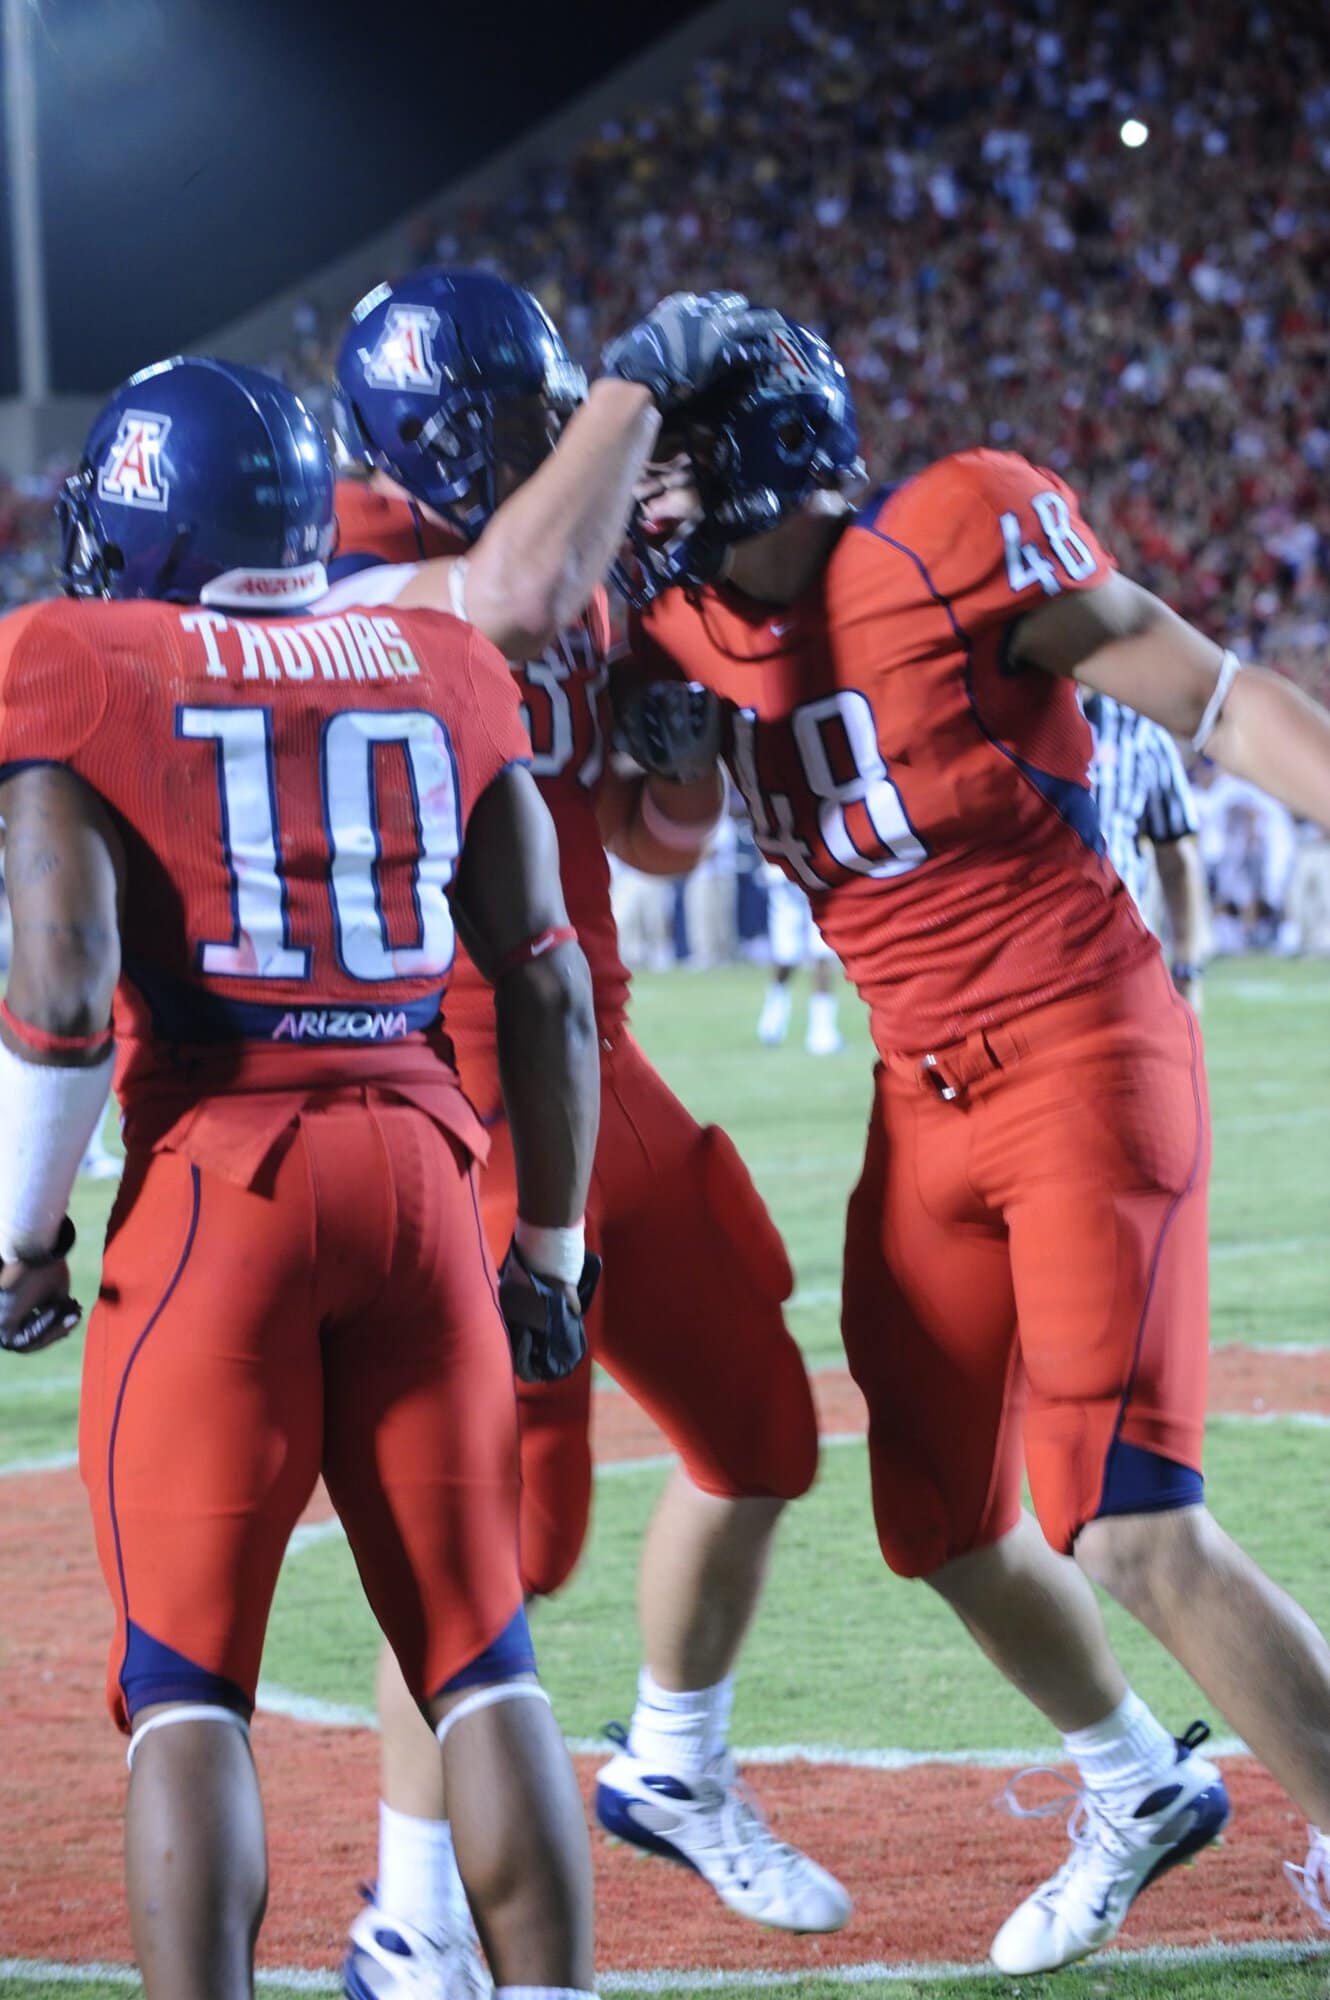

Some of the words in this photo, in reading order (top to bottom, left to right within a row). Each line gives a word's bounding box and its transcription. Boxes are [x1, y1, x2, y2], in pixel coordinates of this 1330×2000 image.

[998, 490, 1098, 598] 48
[179, 611, 422, 686] THOMAS
[174, 704, 462, 983] 10
[732, 688, 928, 891] 48
[271, 1010, 408, 1040] ARIZONA
